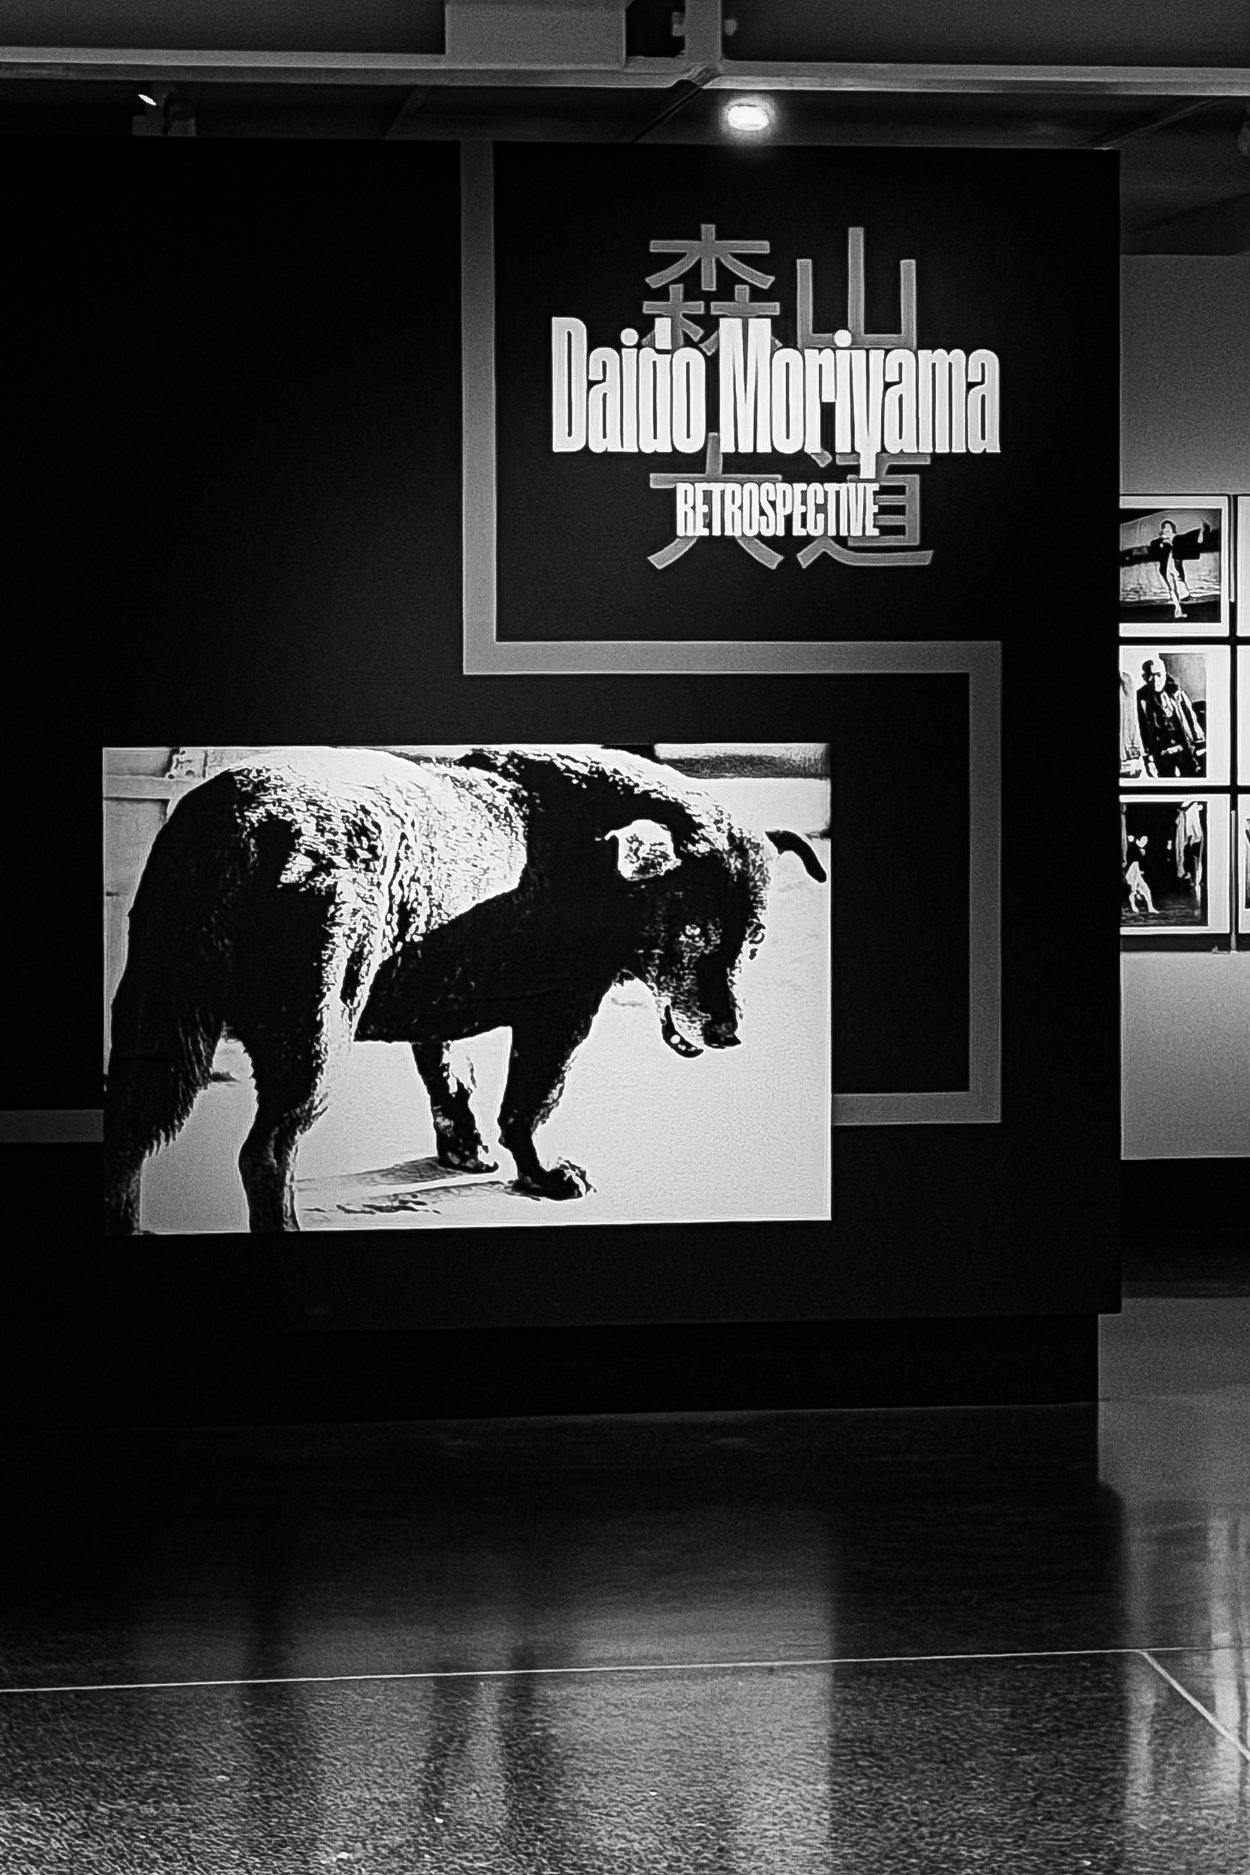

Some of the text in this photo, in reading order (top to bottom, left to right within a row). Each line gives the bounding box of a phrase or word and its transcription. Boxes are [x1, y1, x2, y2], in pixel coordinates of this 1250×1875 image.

[551, 316, 1002, 479] Daido Moriyama
[676, 481, 881, 537] RETROSPECTIVE
